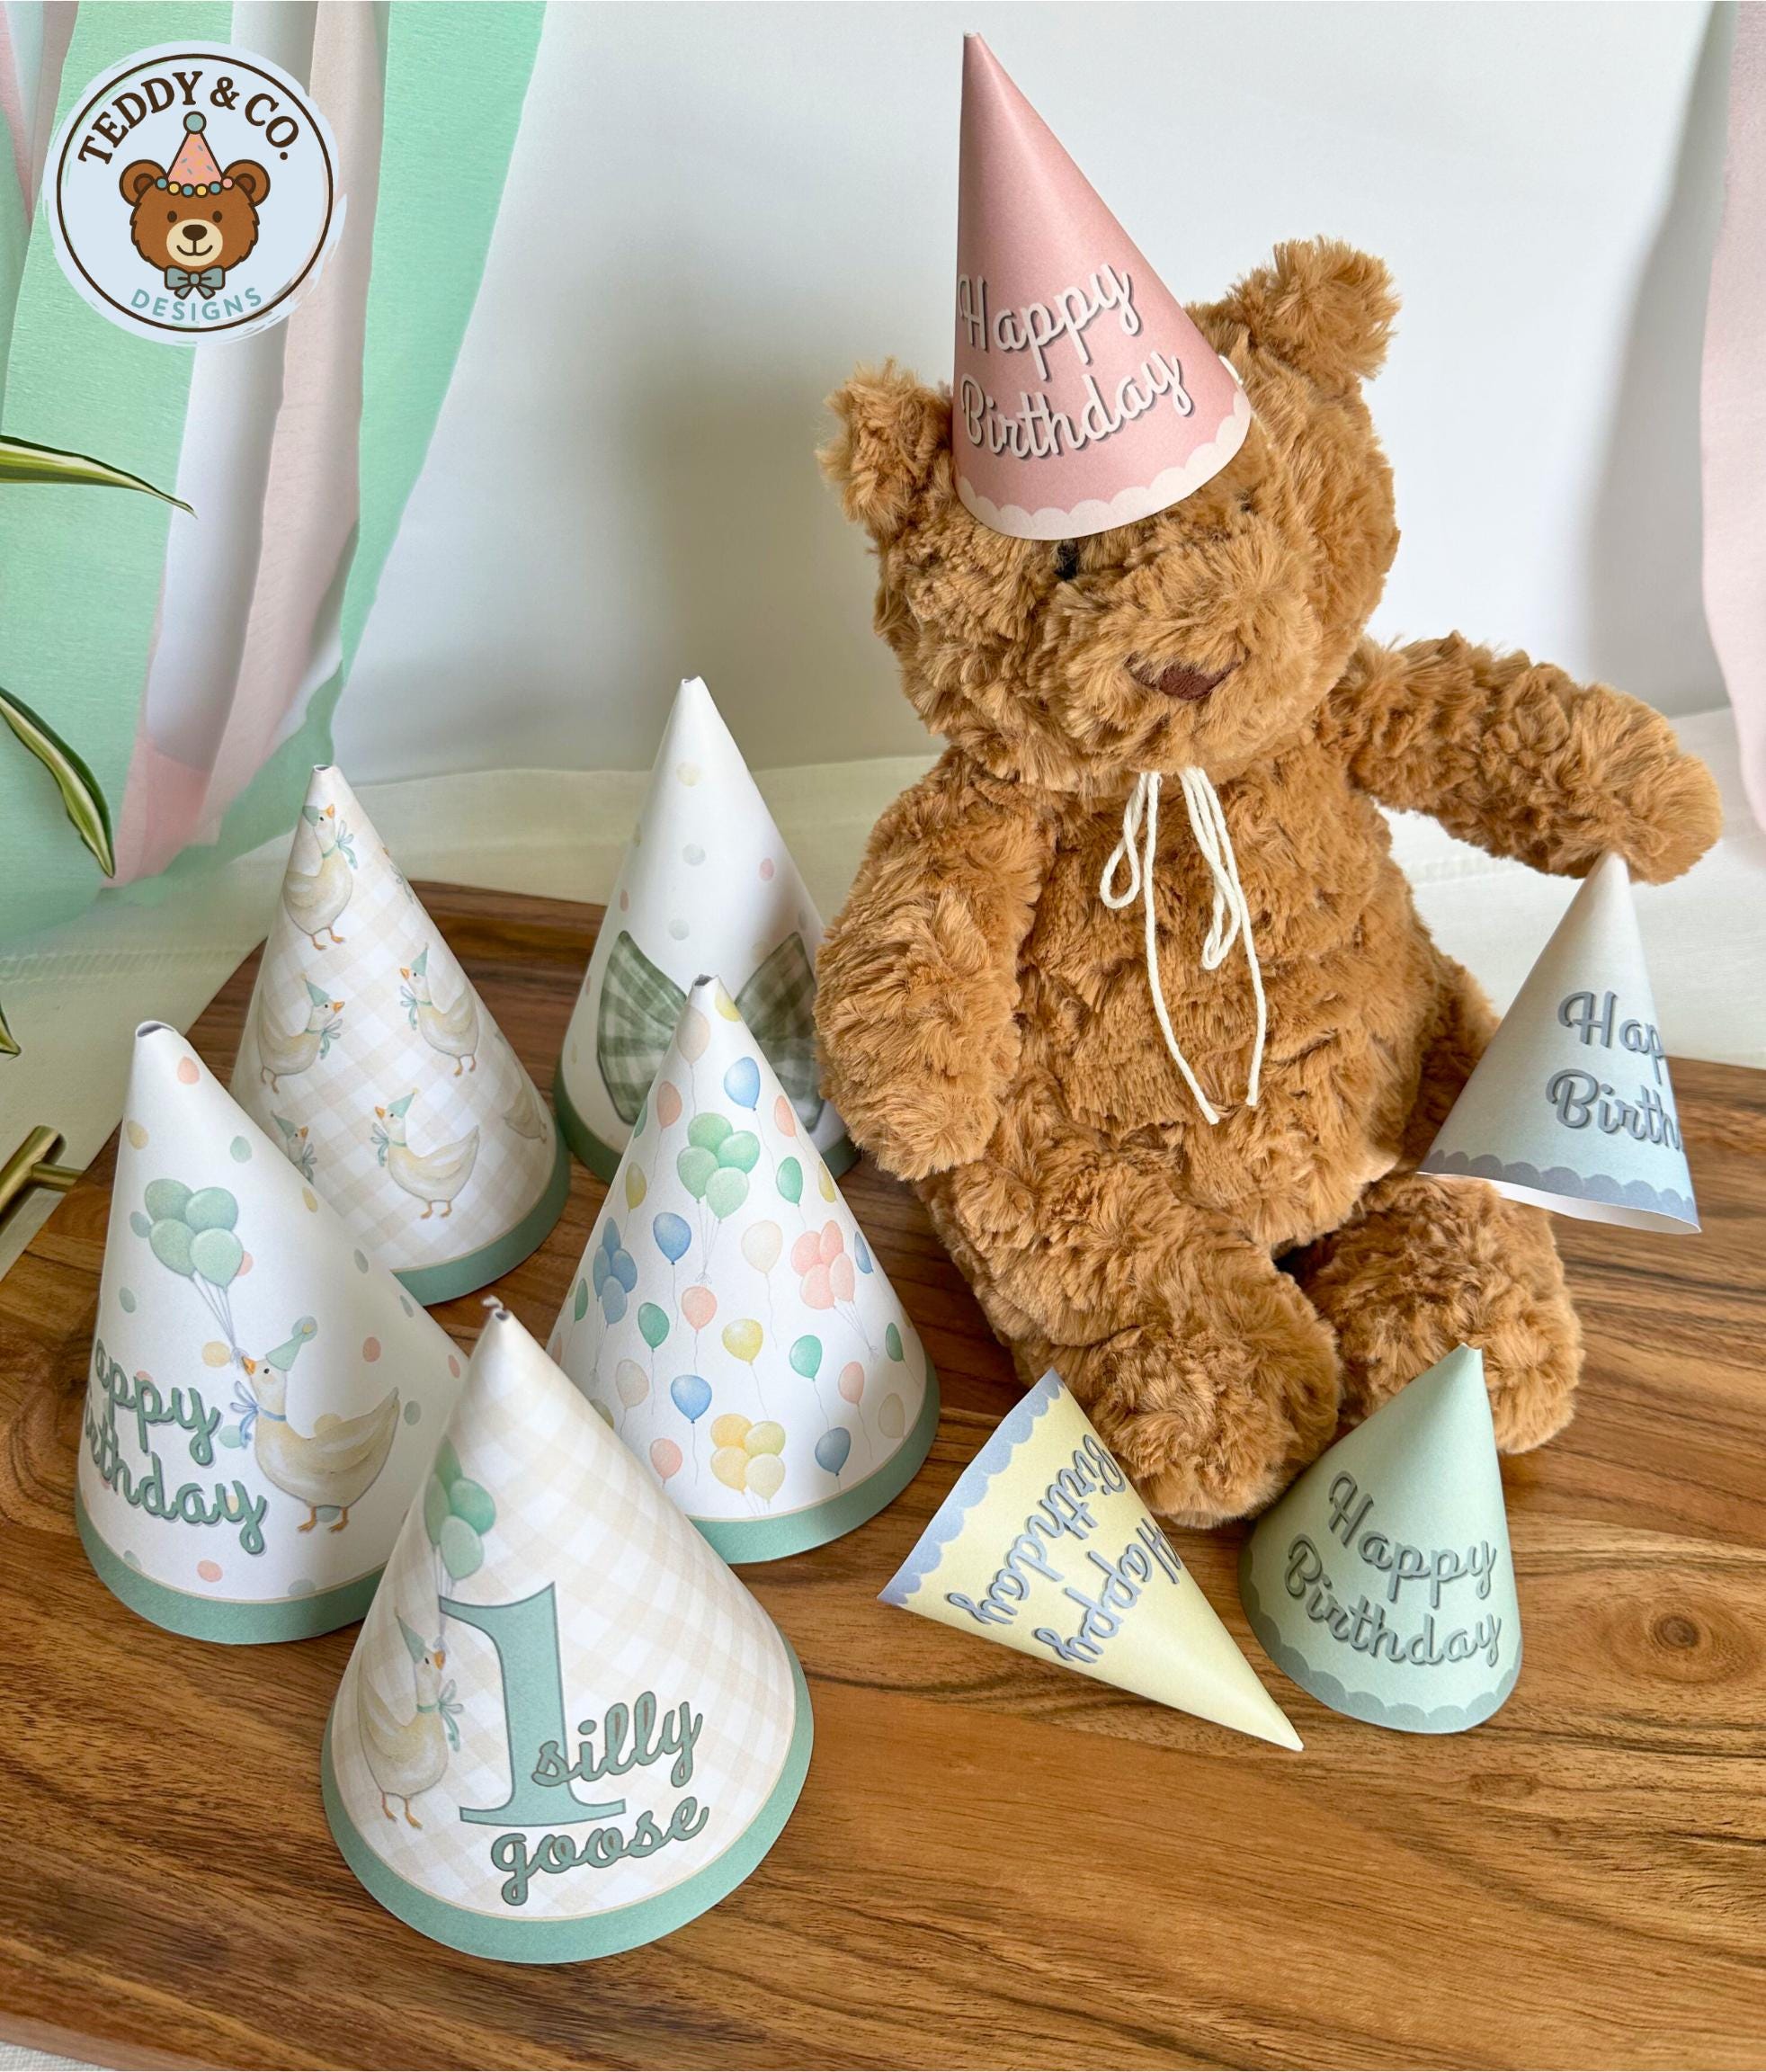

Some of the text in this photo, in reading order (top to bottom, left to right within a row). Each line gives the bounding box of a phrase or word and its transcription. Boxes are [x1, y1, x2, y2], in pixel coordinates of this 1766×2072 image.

[958, 263, 1143, 381] Happy
[961, 351, 1196, 460] Birthday
[1557, 990, 1665, 1085] Hap
[1546, 1068, 1684, 1155] Birth
[95, 1338, 222, 1467] appy
[85, 1405, 268, 1556] rthday
[948, 1433, 1126, 1625] Birthday
[1327, 1469, 1497, 1610] Happy
[1033, 1517, 1182, 1664] Happy
[1284, 1533, 1502, 1667] Birthday
[439, 1581, 627, 1826] 1
[532, 1691, 703, 1788] silly
[490, 1796, 709, 1906] goose
